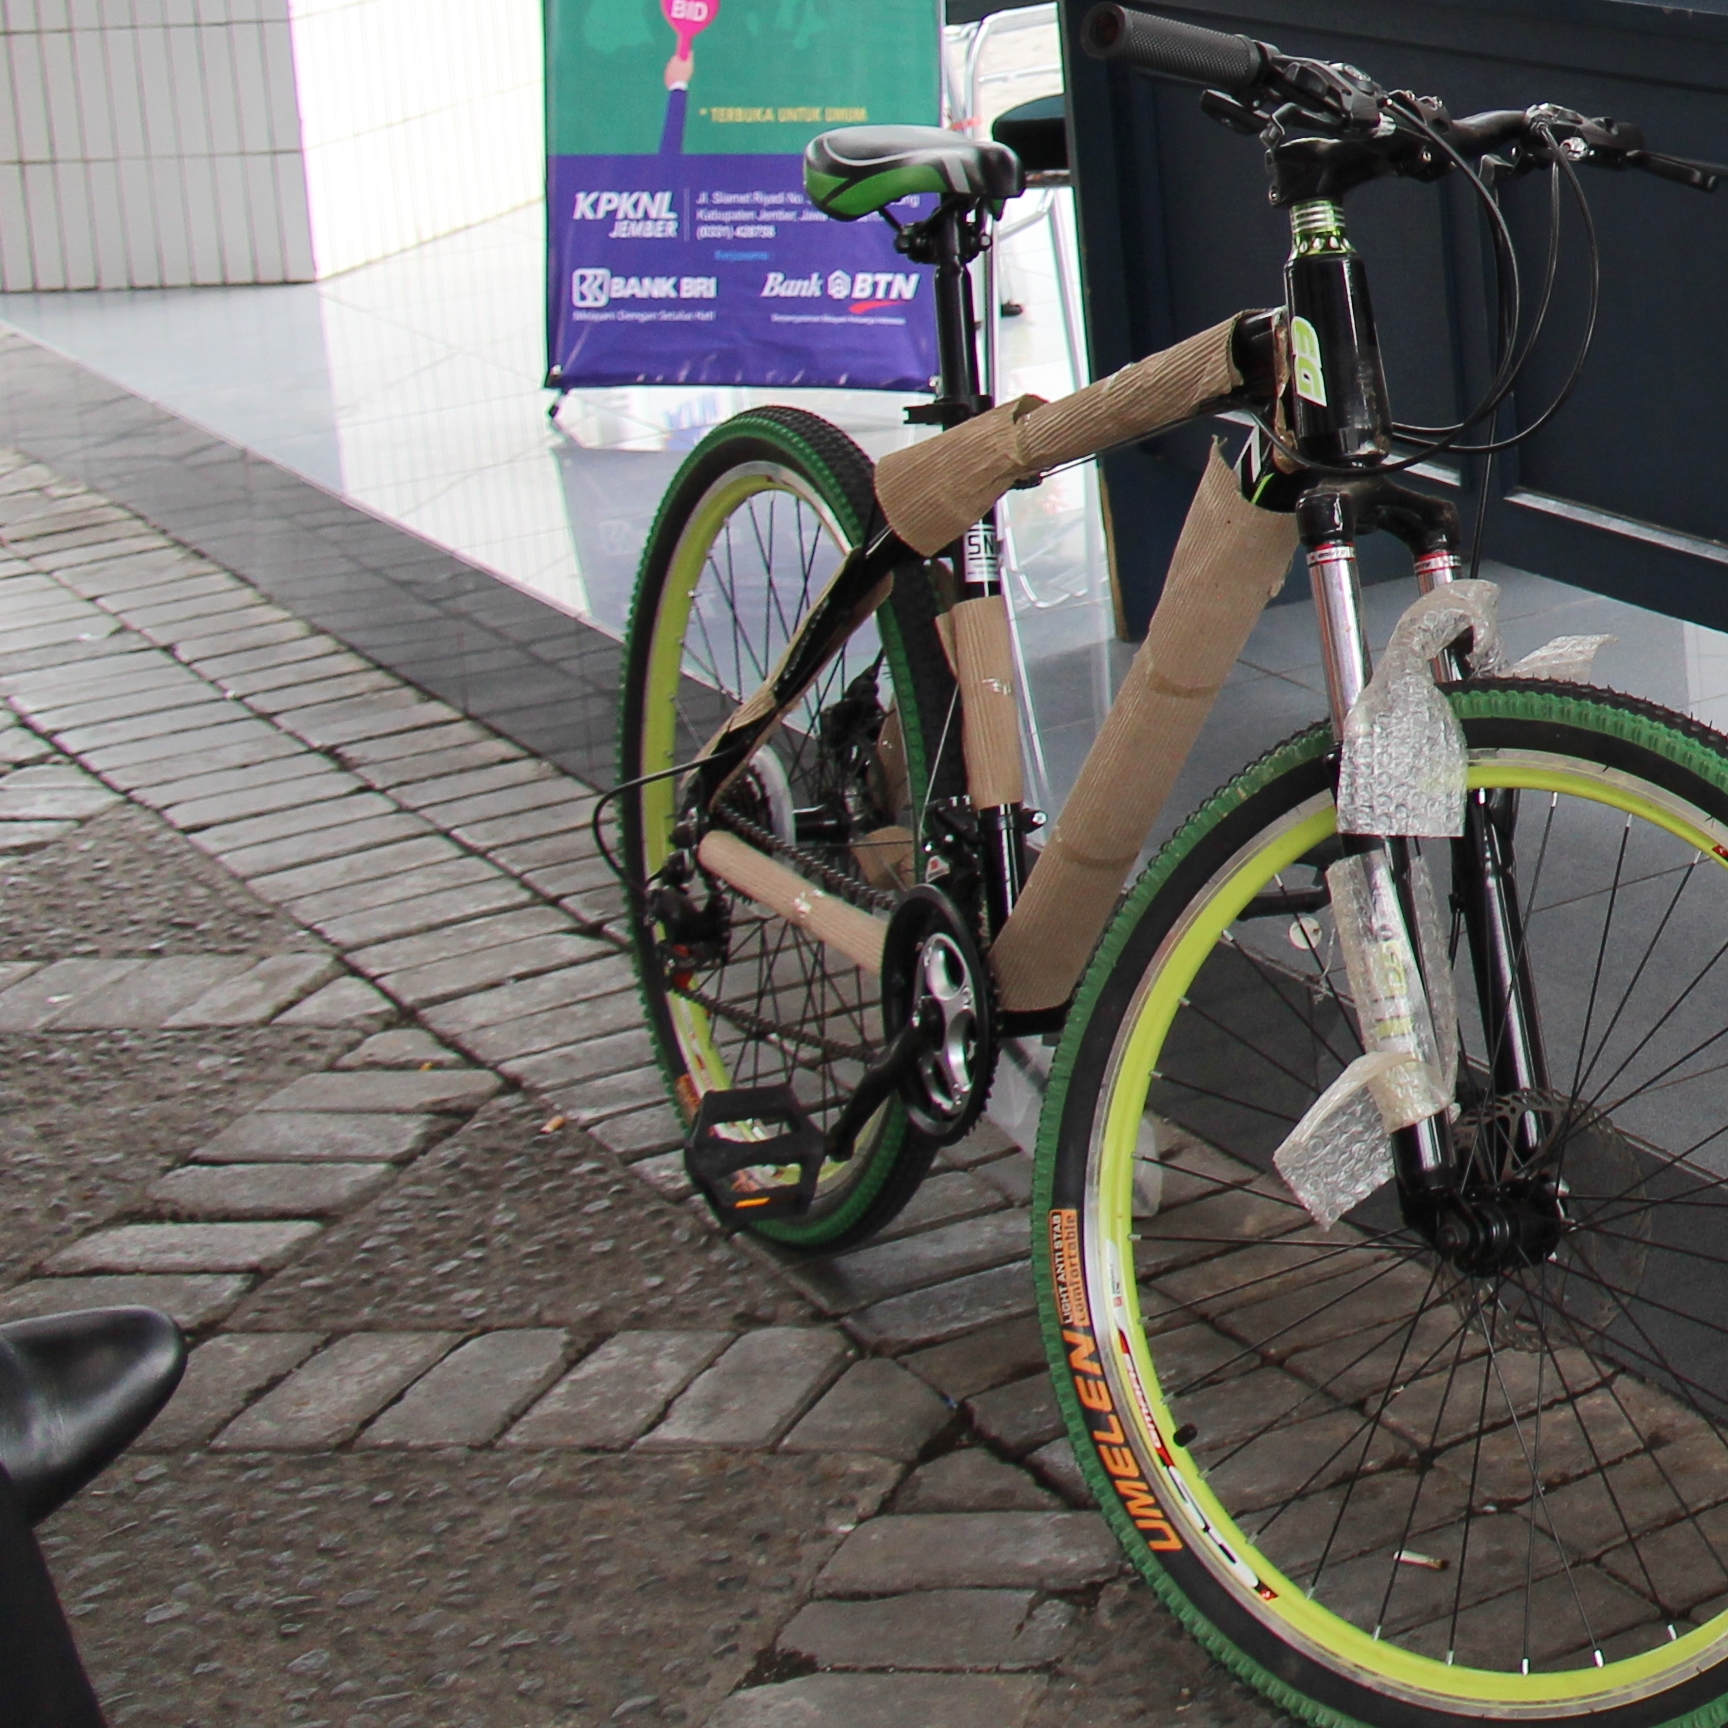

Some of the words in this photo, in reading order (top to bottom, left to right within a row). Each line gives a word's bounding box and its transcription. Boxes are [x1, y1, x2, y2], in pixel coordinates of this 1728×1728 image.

[573, 191, 679, 221] KPKNL
[609, 220, 679, 240] JEMBER
[609, 276, 678, 300] BANK
[679, 275, 718, 299] BRI
[761, 272, 825, 299] Bank
[851, 272, 921, 300] BTN
[1050, 1213, 1063, 1248] STAB
[1055, 1249, 1068, 1285] ANTI
[1064, 1213, 1087, 1324] comfortable
[1061, 1283, 1075, 1325] LIGHT
